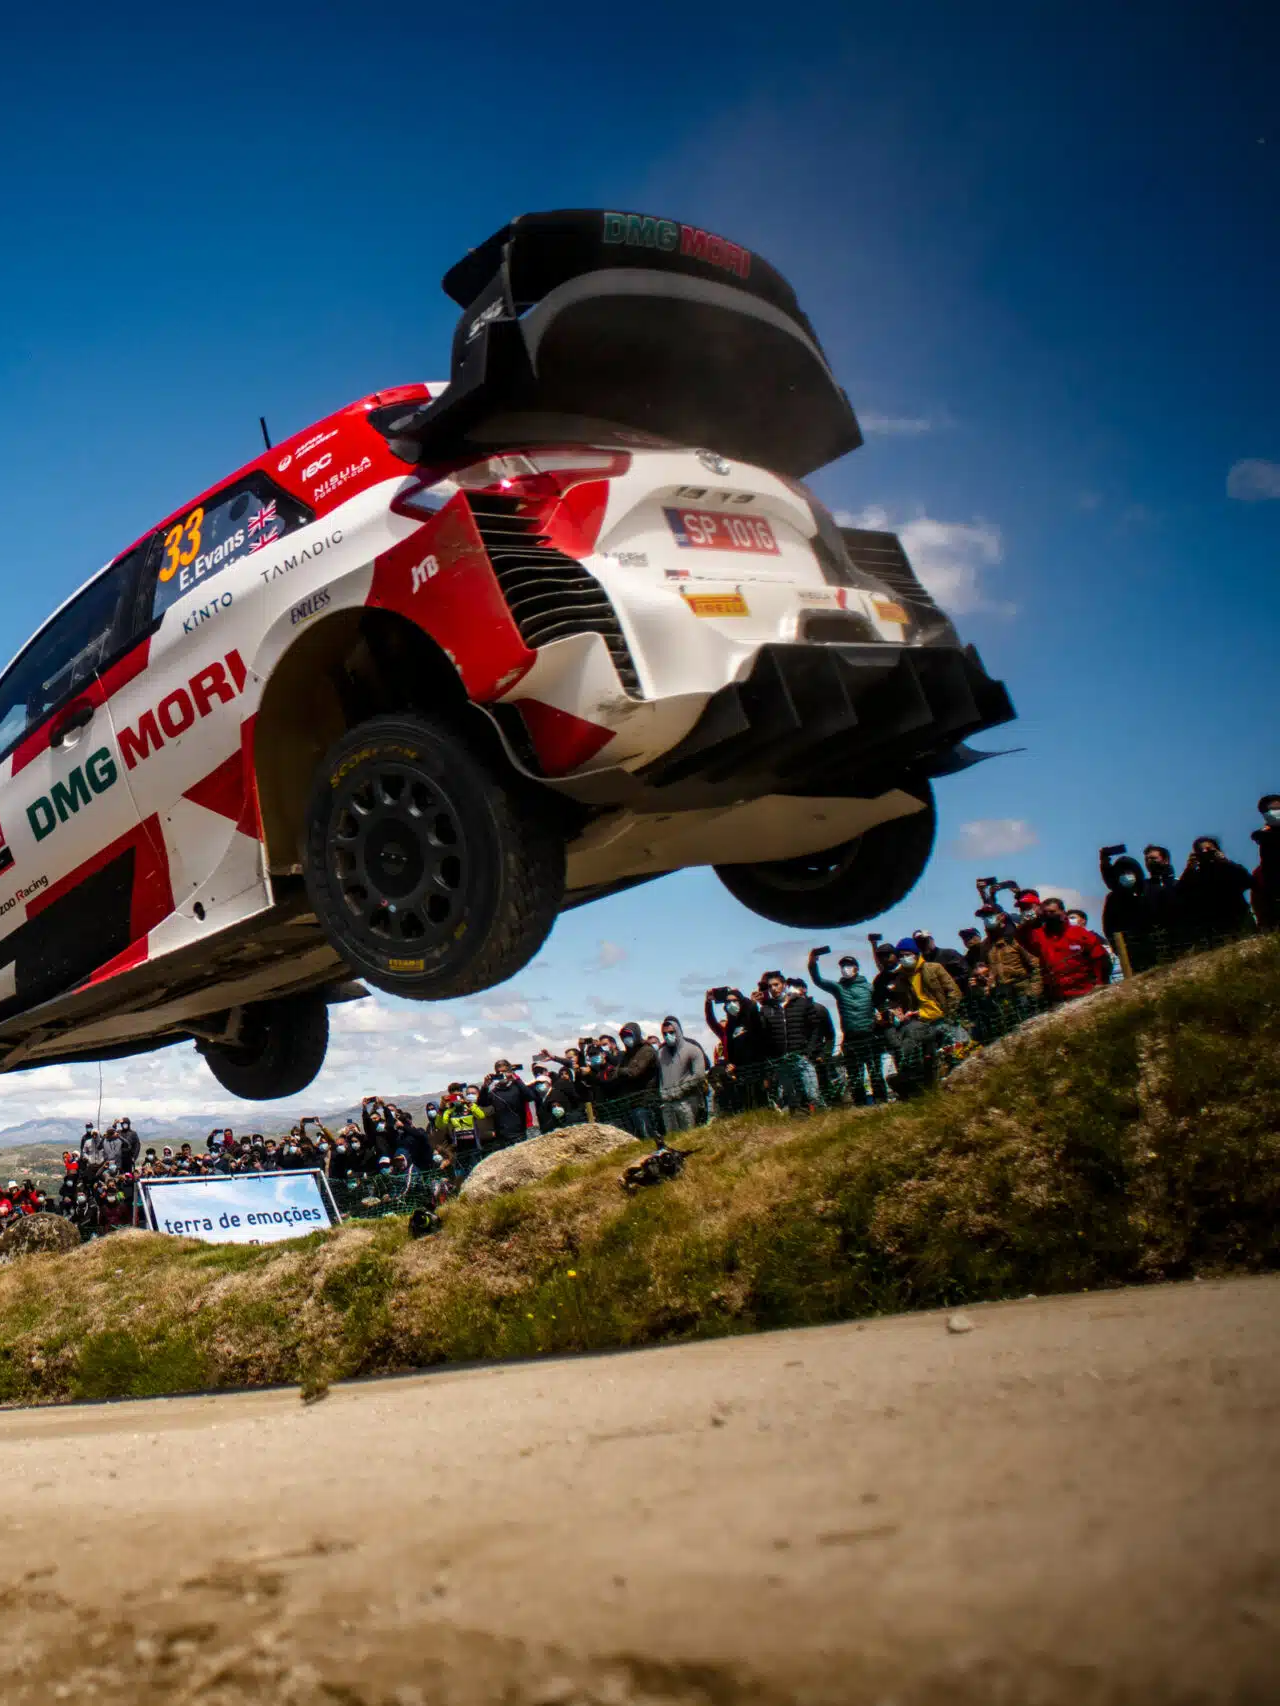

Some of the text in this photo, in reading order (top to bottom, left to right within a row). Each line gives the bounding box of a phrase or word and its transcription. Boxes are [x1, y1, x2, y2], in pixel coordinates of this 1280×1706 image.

[604, 212, 751, 280] DMG MORI
[314, 456, 371, 496] NISULA
[158, 507, 204, 582] 33
[683, 514, 774, 550] SP 1016
[260, 530, 343, 583] TAMADIC
[411, 554, 440, 594] JTB
[290, 588, 331, 625] ENDLESS
[25, 746, 118, 842] DMG
[117, 648, 247, 770] MORI
[16, 875, 49, 902] Racing
[164, 1206, 321, 1235] terra de emoções
